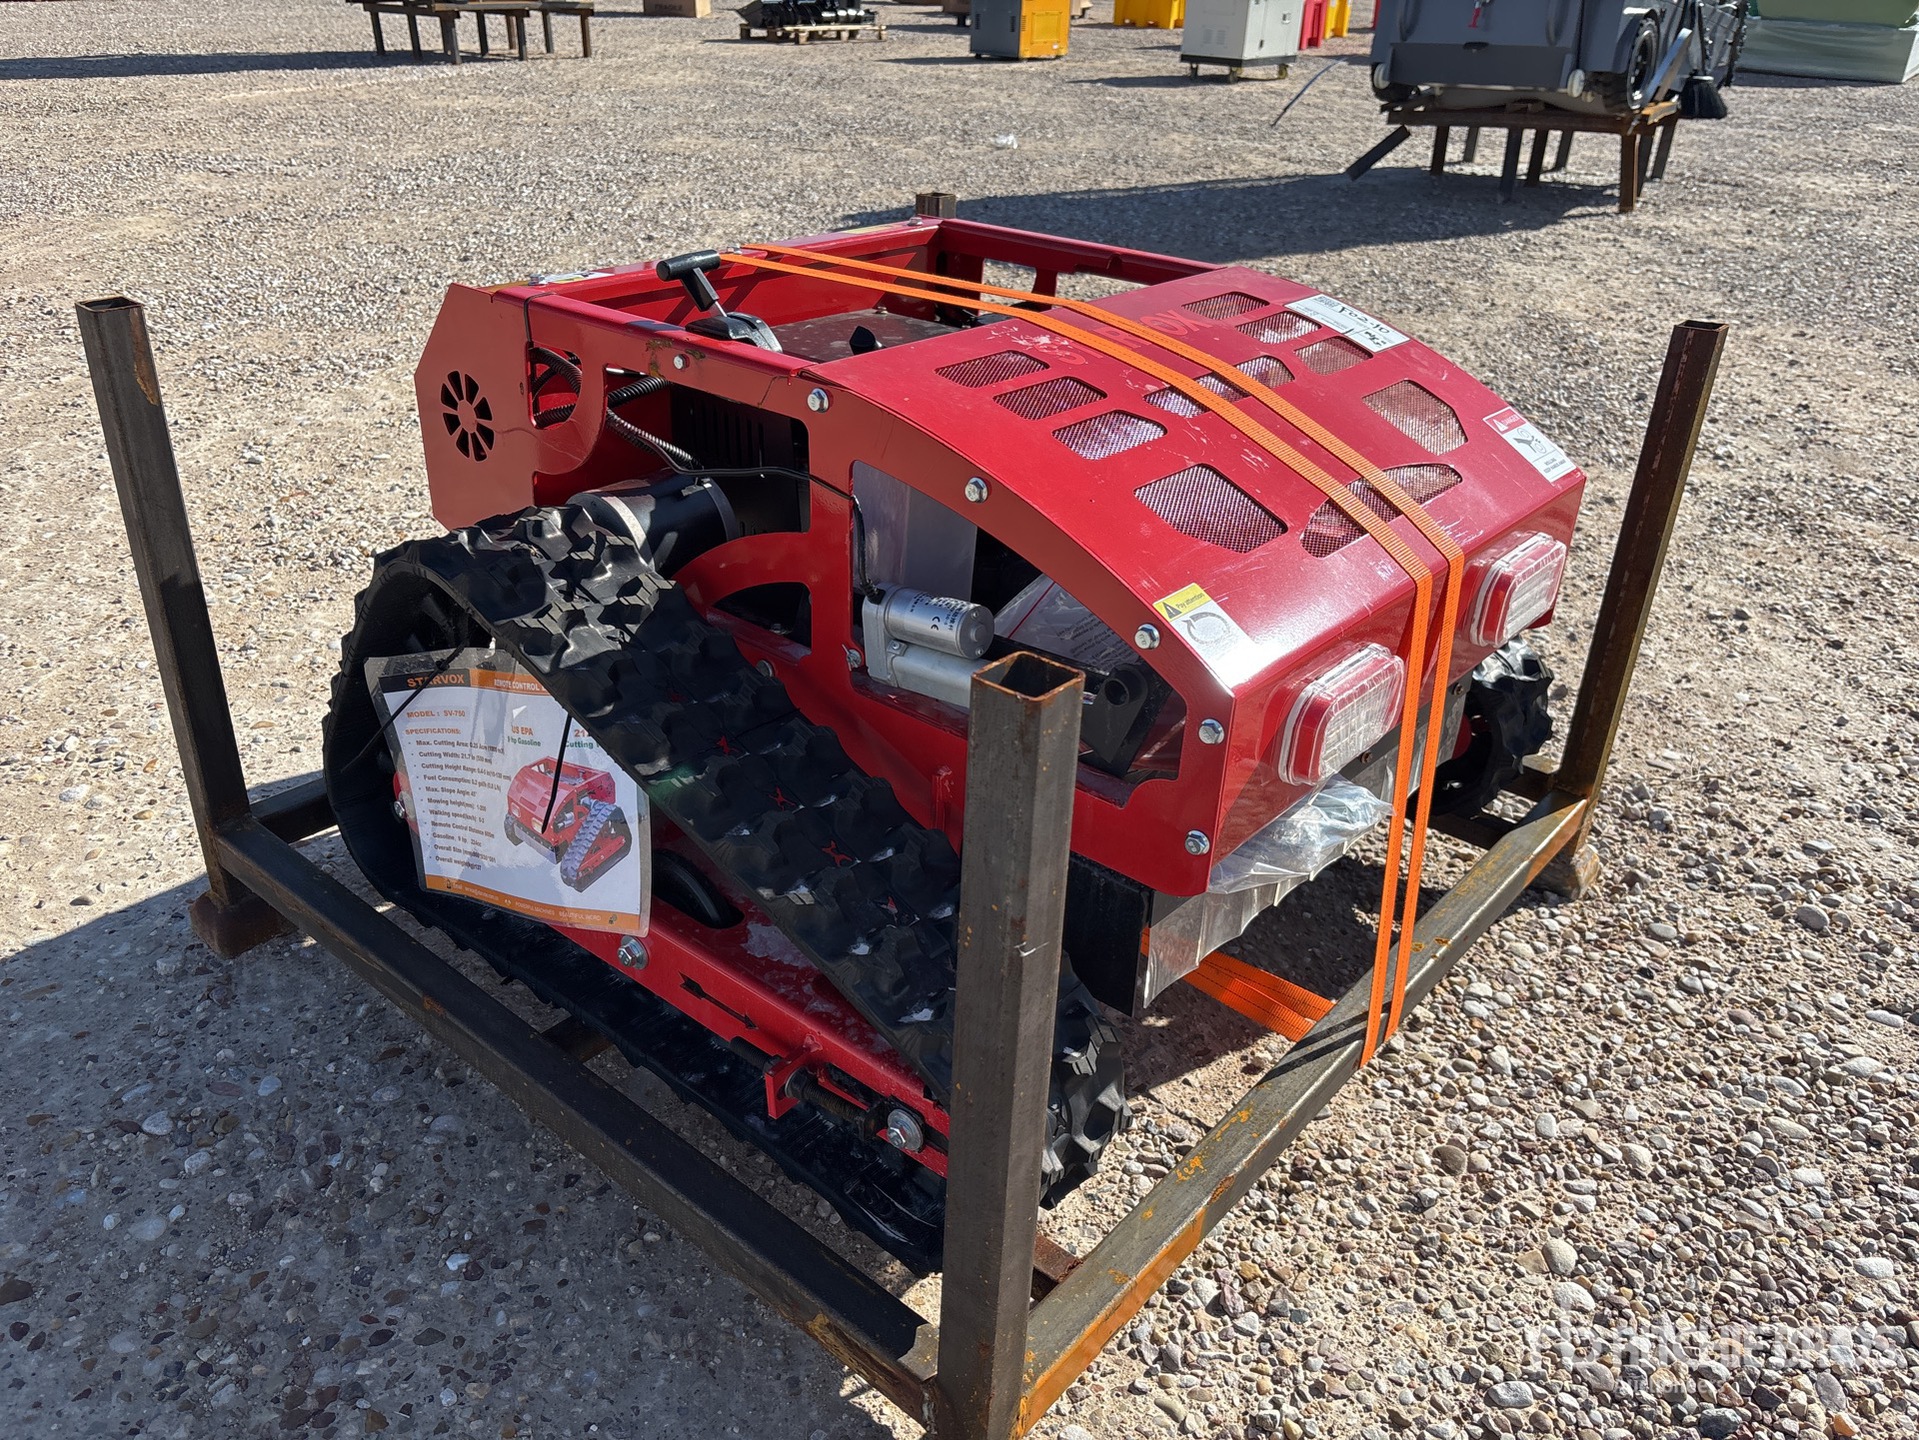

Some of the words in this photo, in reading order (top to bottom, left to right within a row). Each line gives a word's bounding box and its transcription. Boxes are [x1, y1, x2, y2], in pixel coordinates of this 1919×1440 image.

[1186, 593, 1205, 606] attention
[512, 680, 540, 691] CONTROL
[512, 726, 520, 734] US
[520, 726, 534, 736] EPA
[518, 738, 541, 747] Gasoline
[429, 809, 450, 818] Walking
